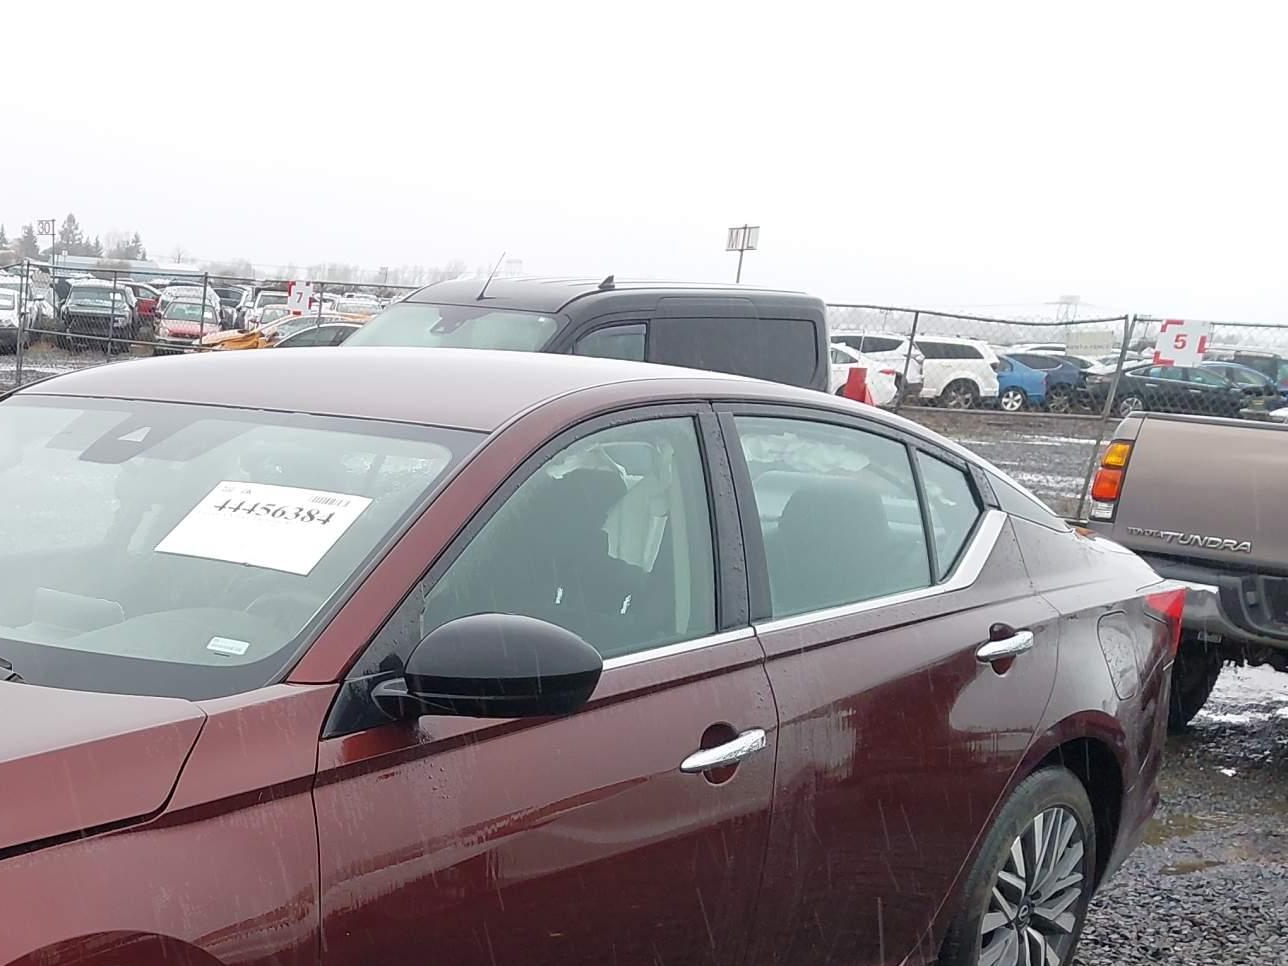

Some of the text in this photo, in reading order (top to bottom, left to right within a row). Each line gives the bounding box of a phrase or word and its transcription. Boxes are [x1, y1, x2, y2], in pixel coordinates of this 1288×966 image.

[296, 291, 304, 303] 7
[1173, 333, 1188, 349] 5
[214, 498, 336, 525] 44456384
[1161, 531, 1252, 553] TUNDRA
